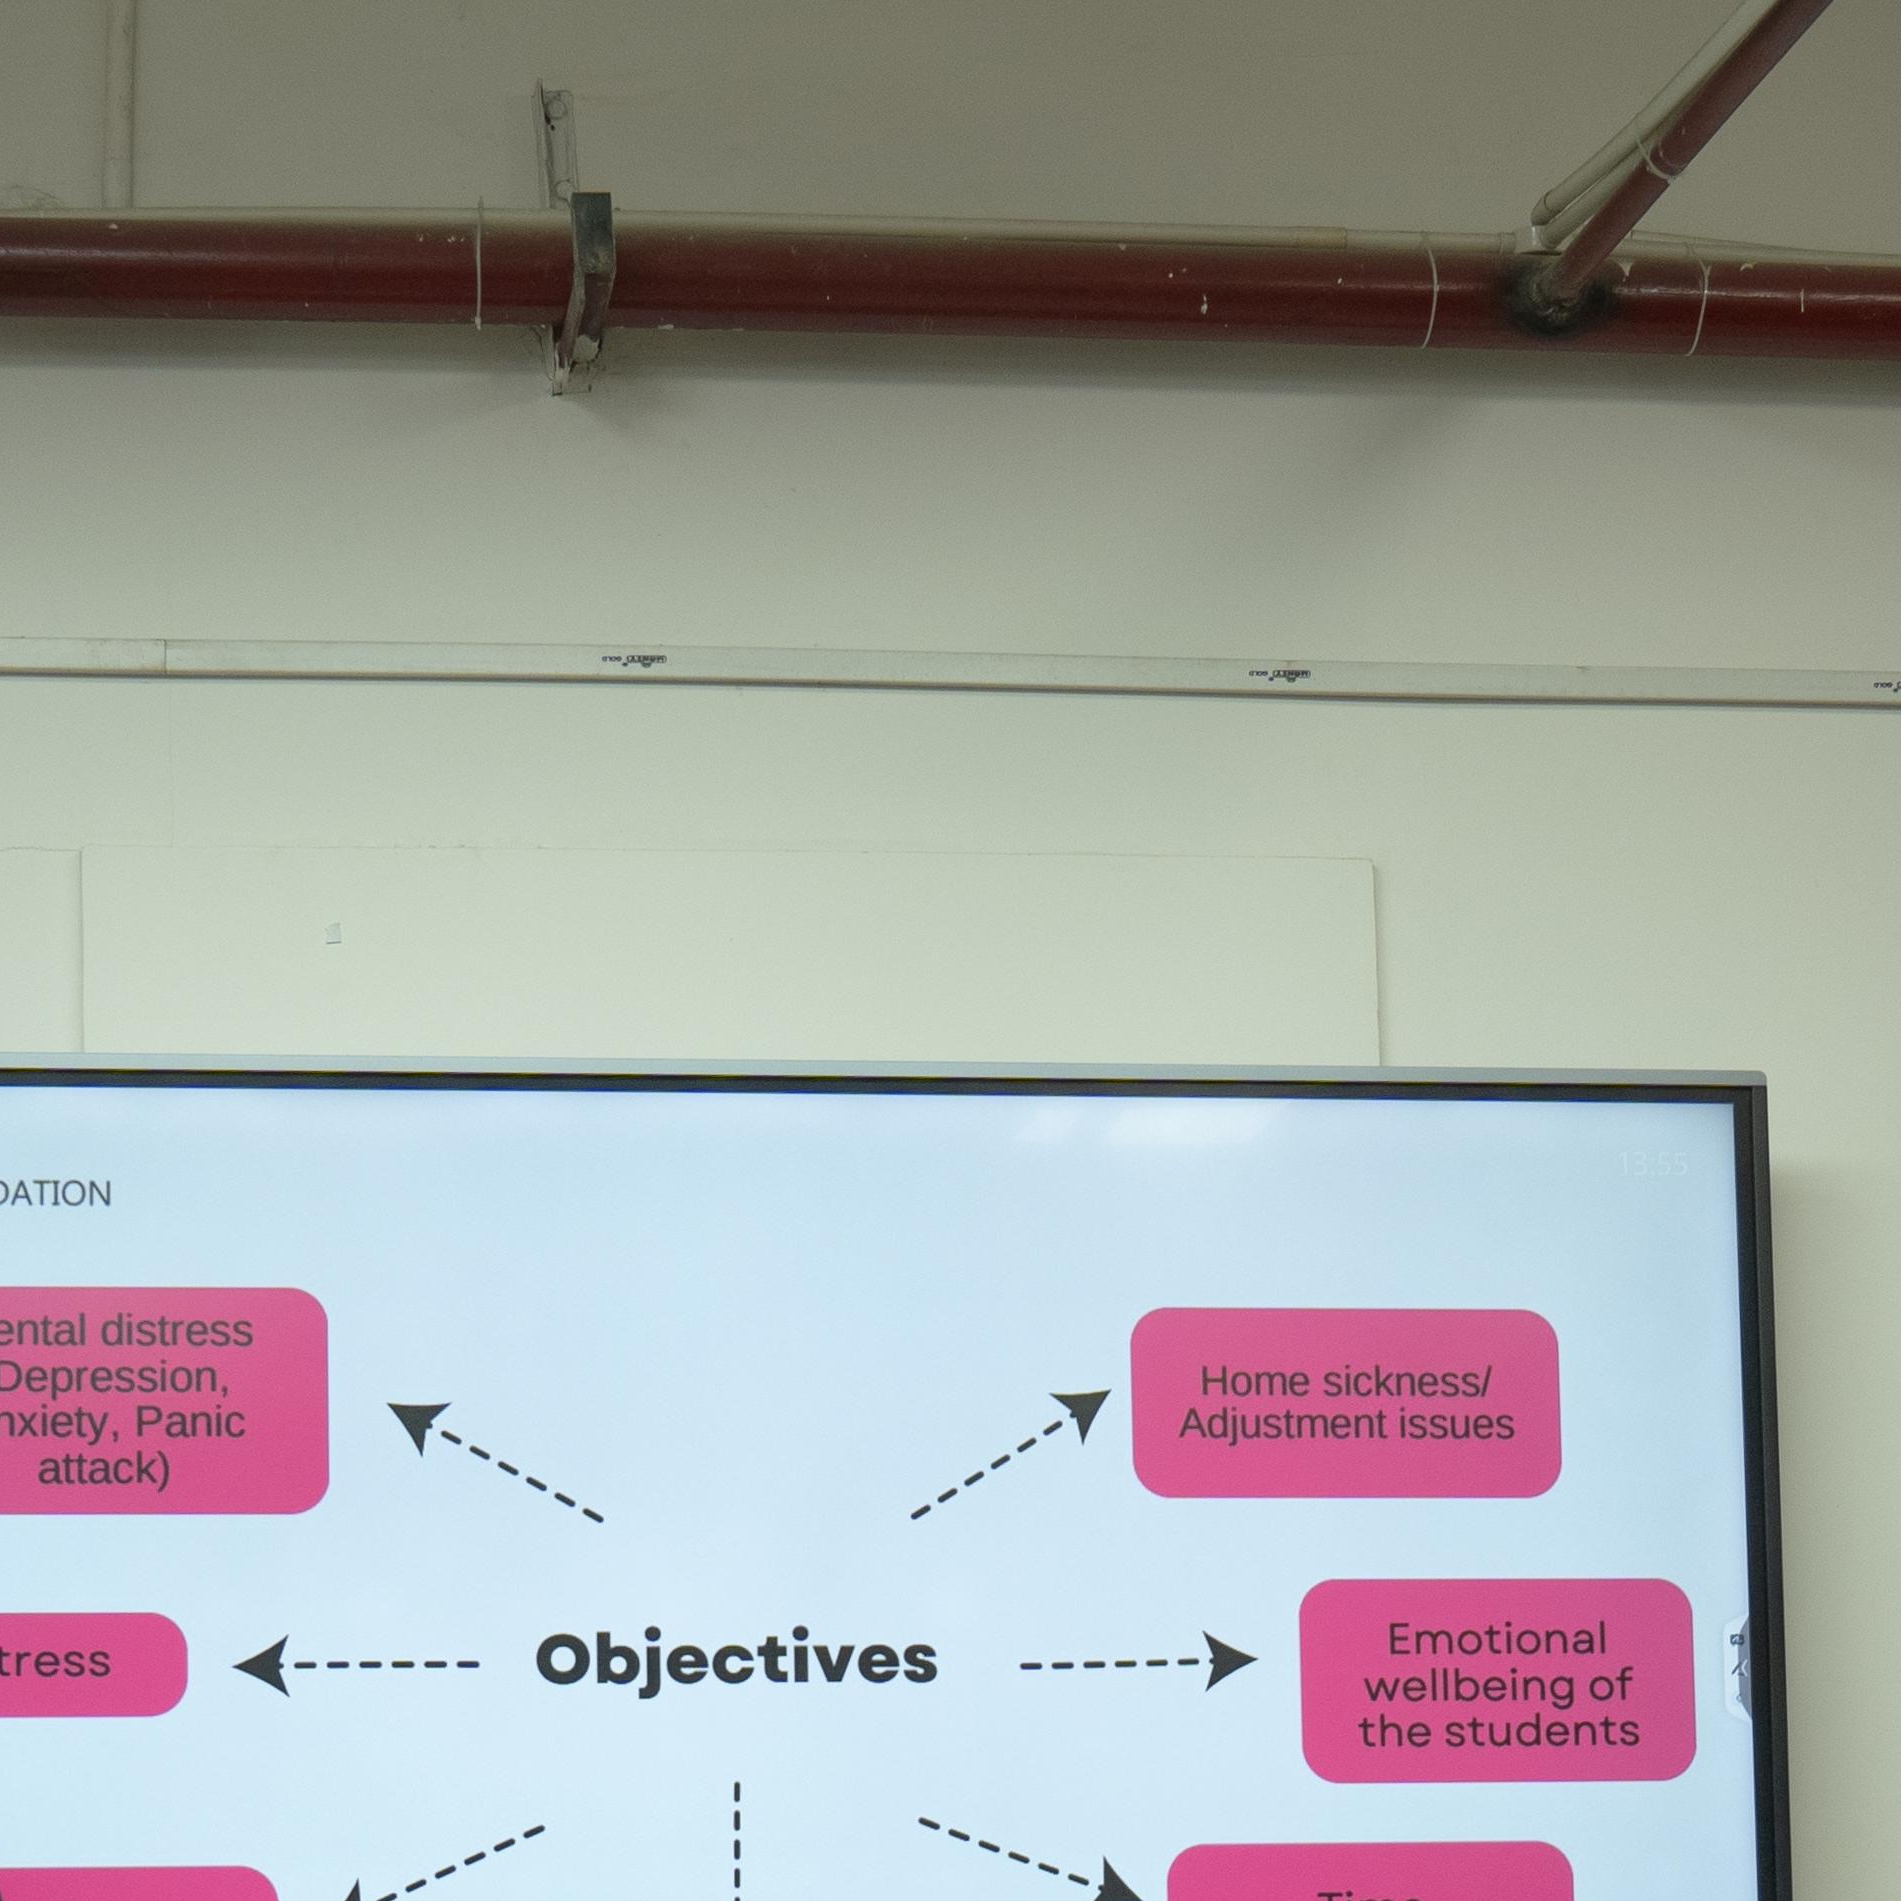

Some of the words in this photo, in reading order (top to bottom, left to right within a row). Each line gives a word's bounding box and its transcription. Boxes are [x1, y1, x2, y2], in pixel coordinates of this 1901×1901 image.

[1618, 1151, 1688, 1176] 13:55
[100, 1312, 254, 1347] distress
[1202, 1365, 1310, 1397] Home
[1323, 1364, 1493, 1398] sickness/
[136, 1403, 246, 1439] Panic
[1178, 1406, 1389, 1447] Adjustment
[1399, 1406, 1516, 1440] issues
[38, 1450, 170, 1493] attack)
[1389, 1620, 1606, 1656] Emotional
[536, 1625, 938, 1700] Objectives
[1363, 1667, 1575, 1711] wellbeing
[1589, 1666, 1634, 1702] of
[1357, 1713, 1432, 1748] the
[1445, 1712, 1640, 1748] students
